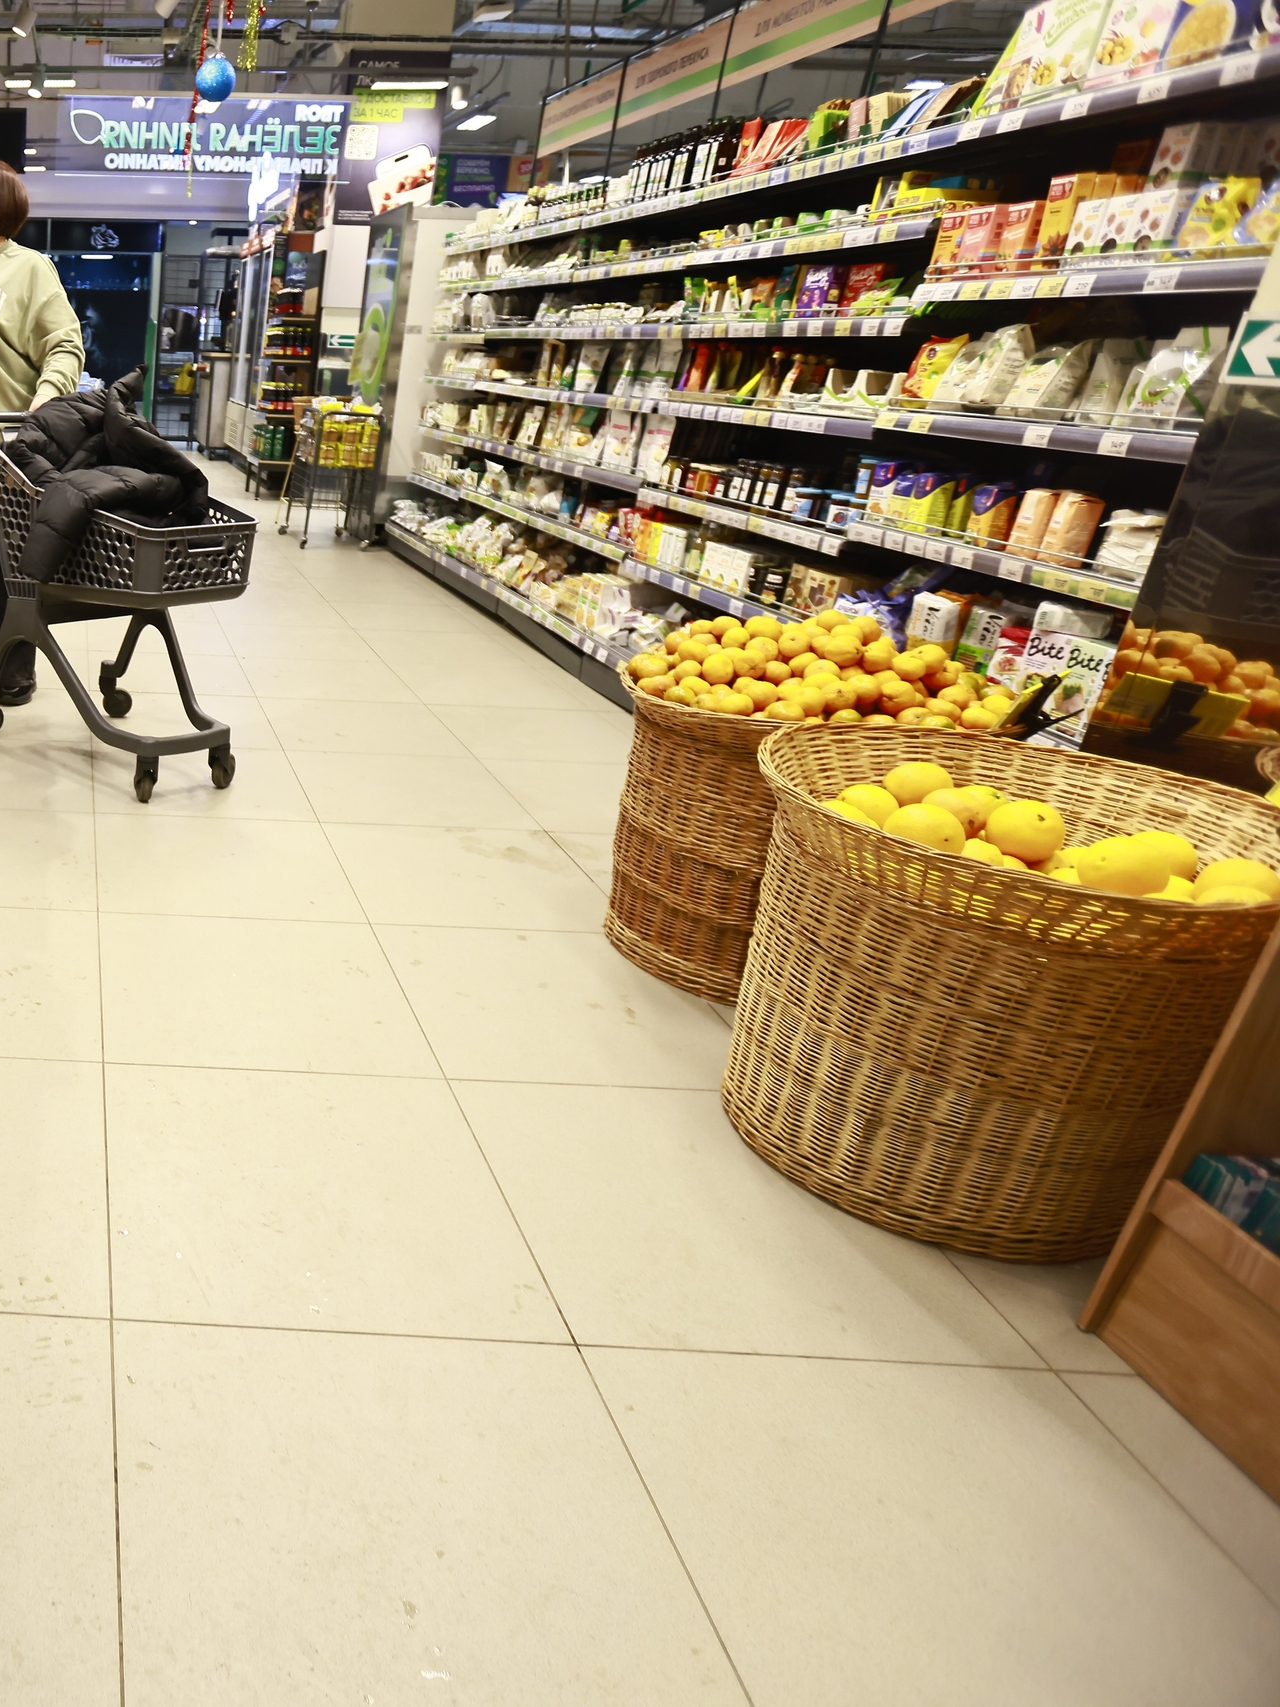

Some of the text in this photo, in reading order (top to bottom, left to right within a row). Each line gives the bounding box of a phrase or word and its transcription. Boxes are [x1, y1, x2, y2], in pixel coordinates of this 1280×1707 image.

[354, 107, 367, 117] ЗА
[376, 107, 399, 118] ЧАС
[1028, 636, 1065, 661] Bite
[1067, 648, 1104, 673] Bite
